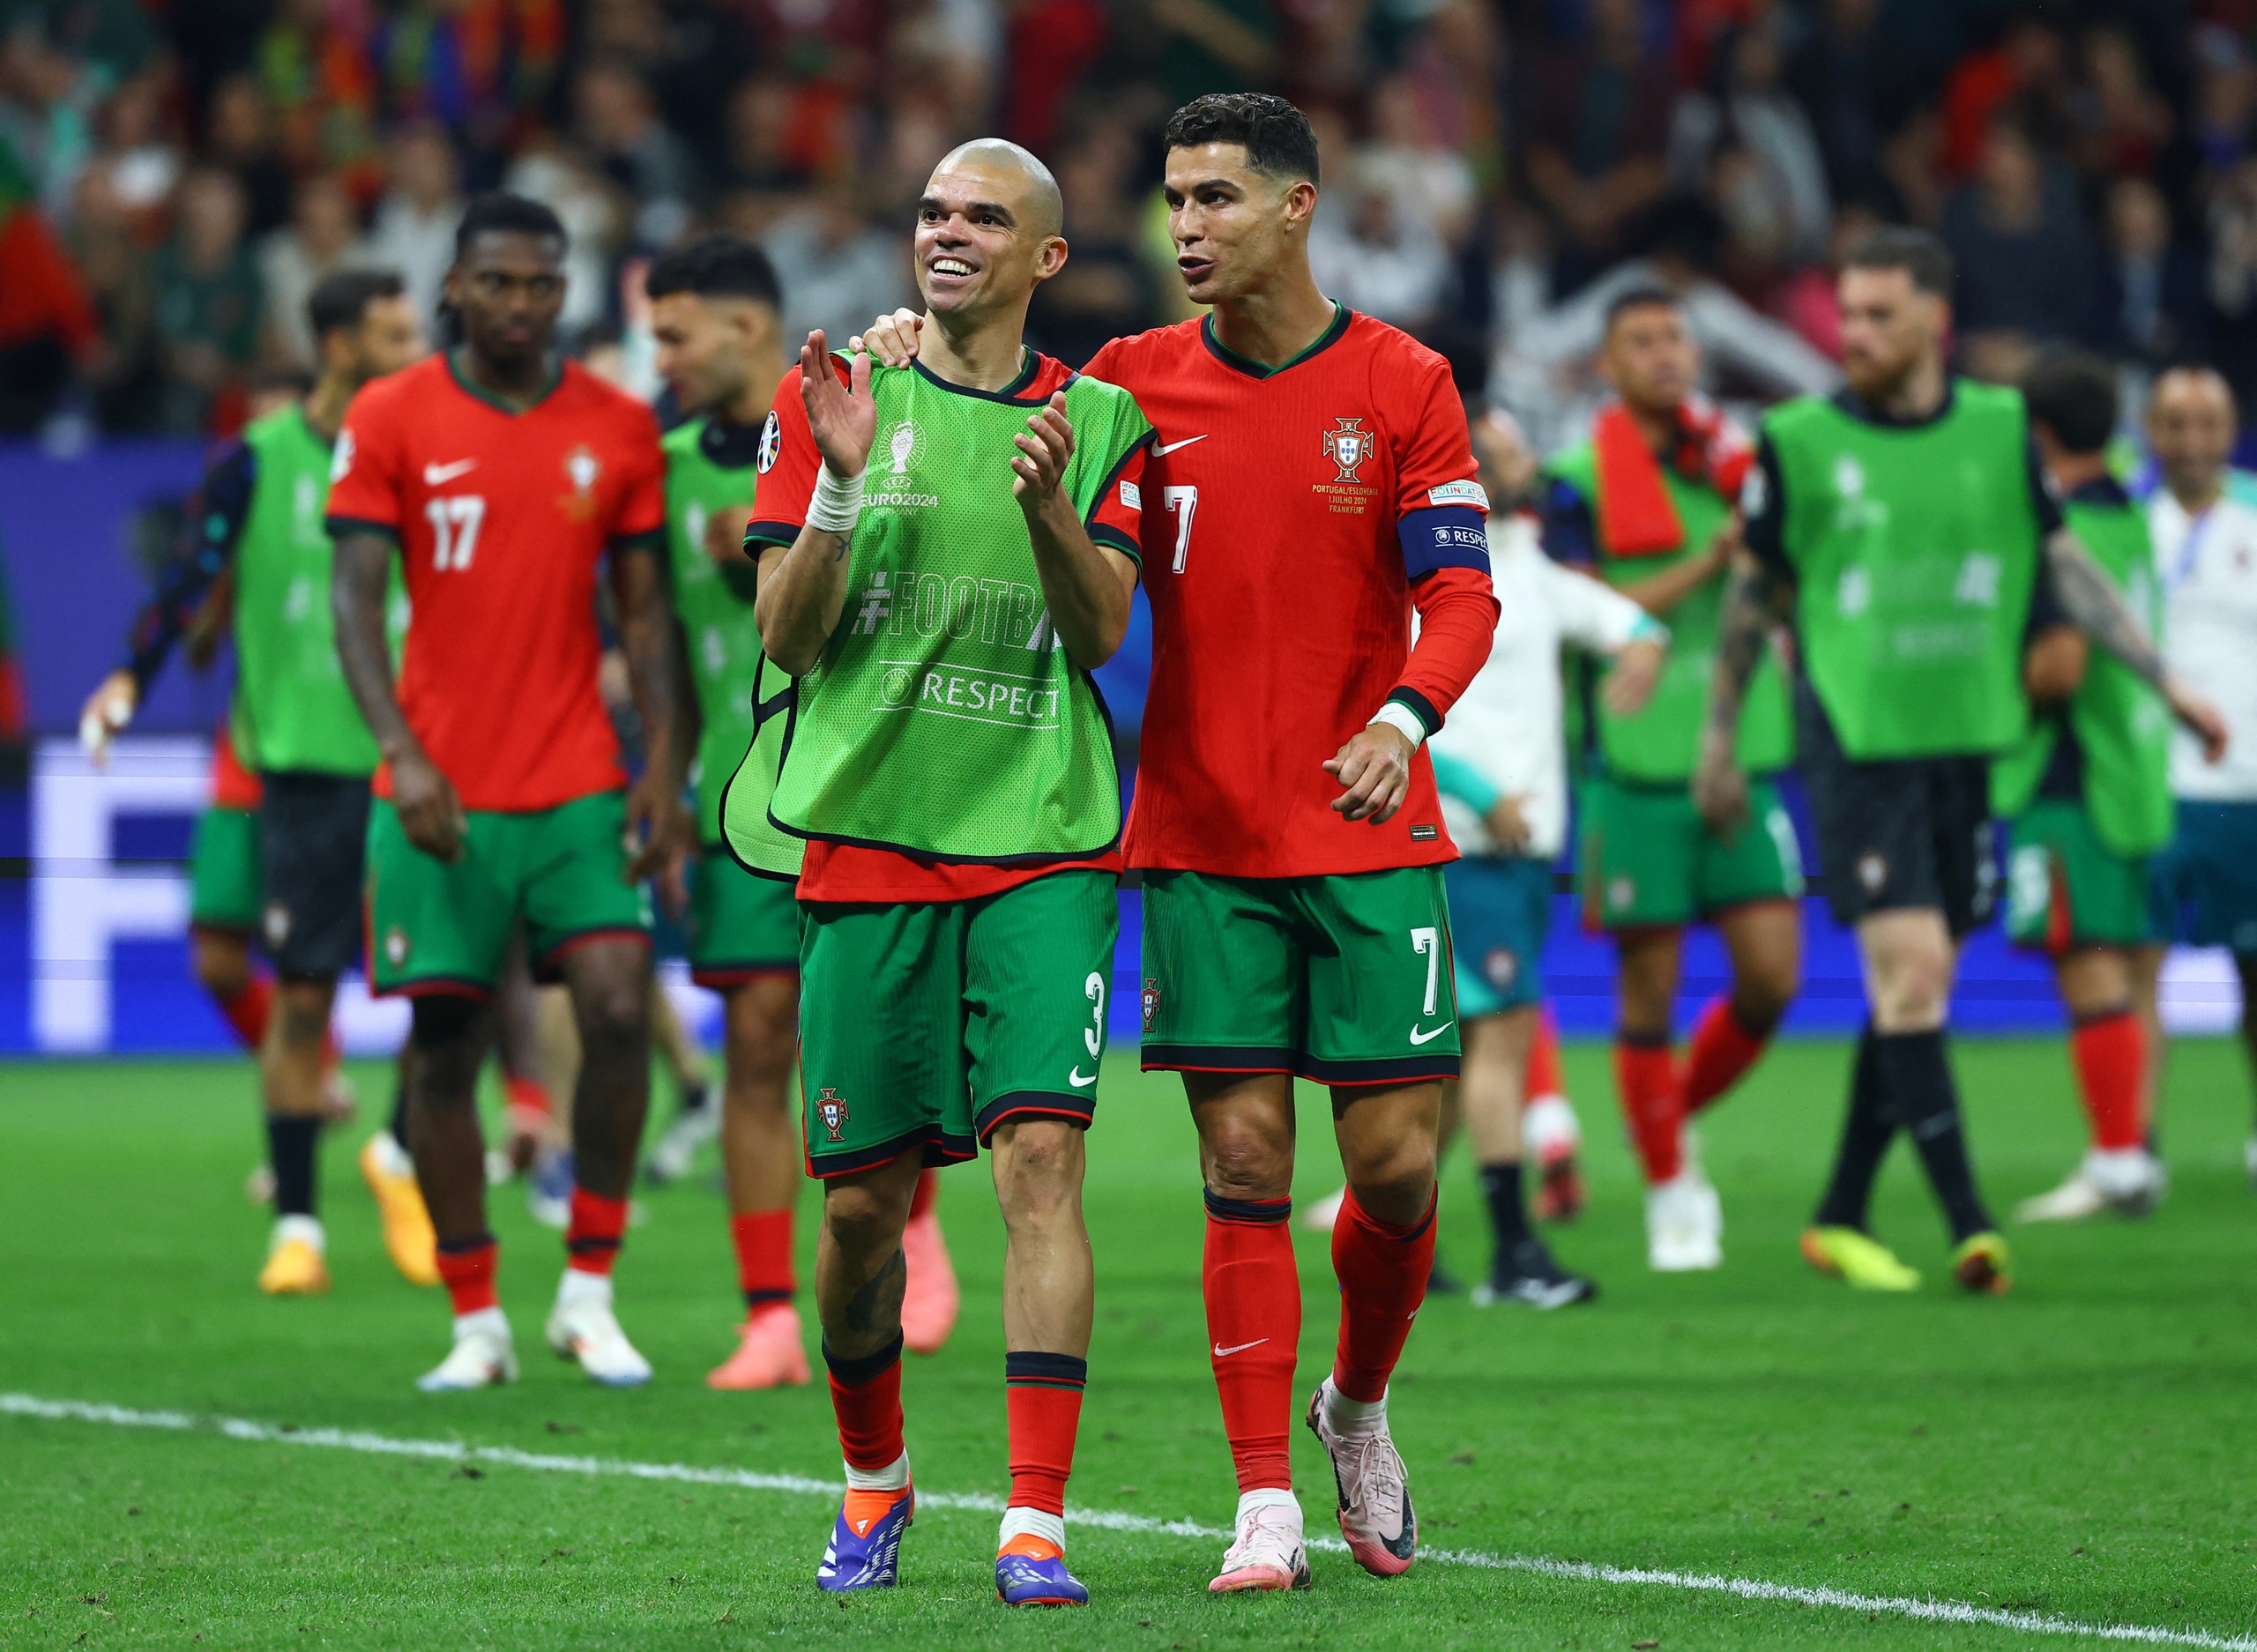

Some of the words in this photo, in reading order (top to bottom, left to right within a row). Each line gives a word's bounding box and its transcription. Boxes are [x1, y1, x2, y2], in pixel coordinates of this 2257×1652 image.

[883, 479, 912, 488] UEFA
[1332, 495, 1352, 504] JULHO
[860, 493, 938, 508] EURO2024
[873, 507, 918, 516] GERMANY
[1329, 504, 1365, 514] FRANKFURT
[424, 496, 485, 571] 17
[1164, 486, 1197, 574] 7
[1454, 531, 1488, 550] RESPEC
[850, 571, 1062, 653] #FOOTBA
[923, 673, 1060, 718] RESPECT
[1411, 926, 1439, 1016] 7
[1084, 971, 1105, 1060] 3
